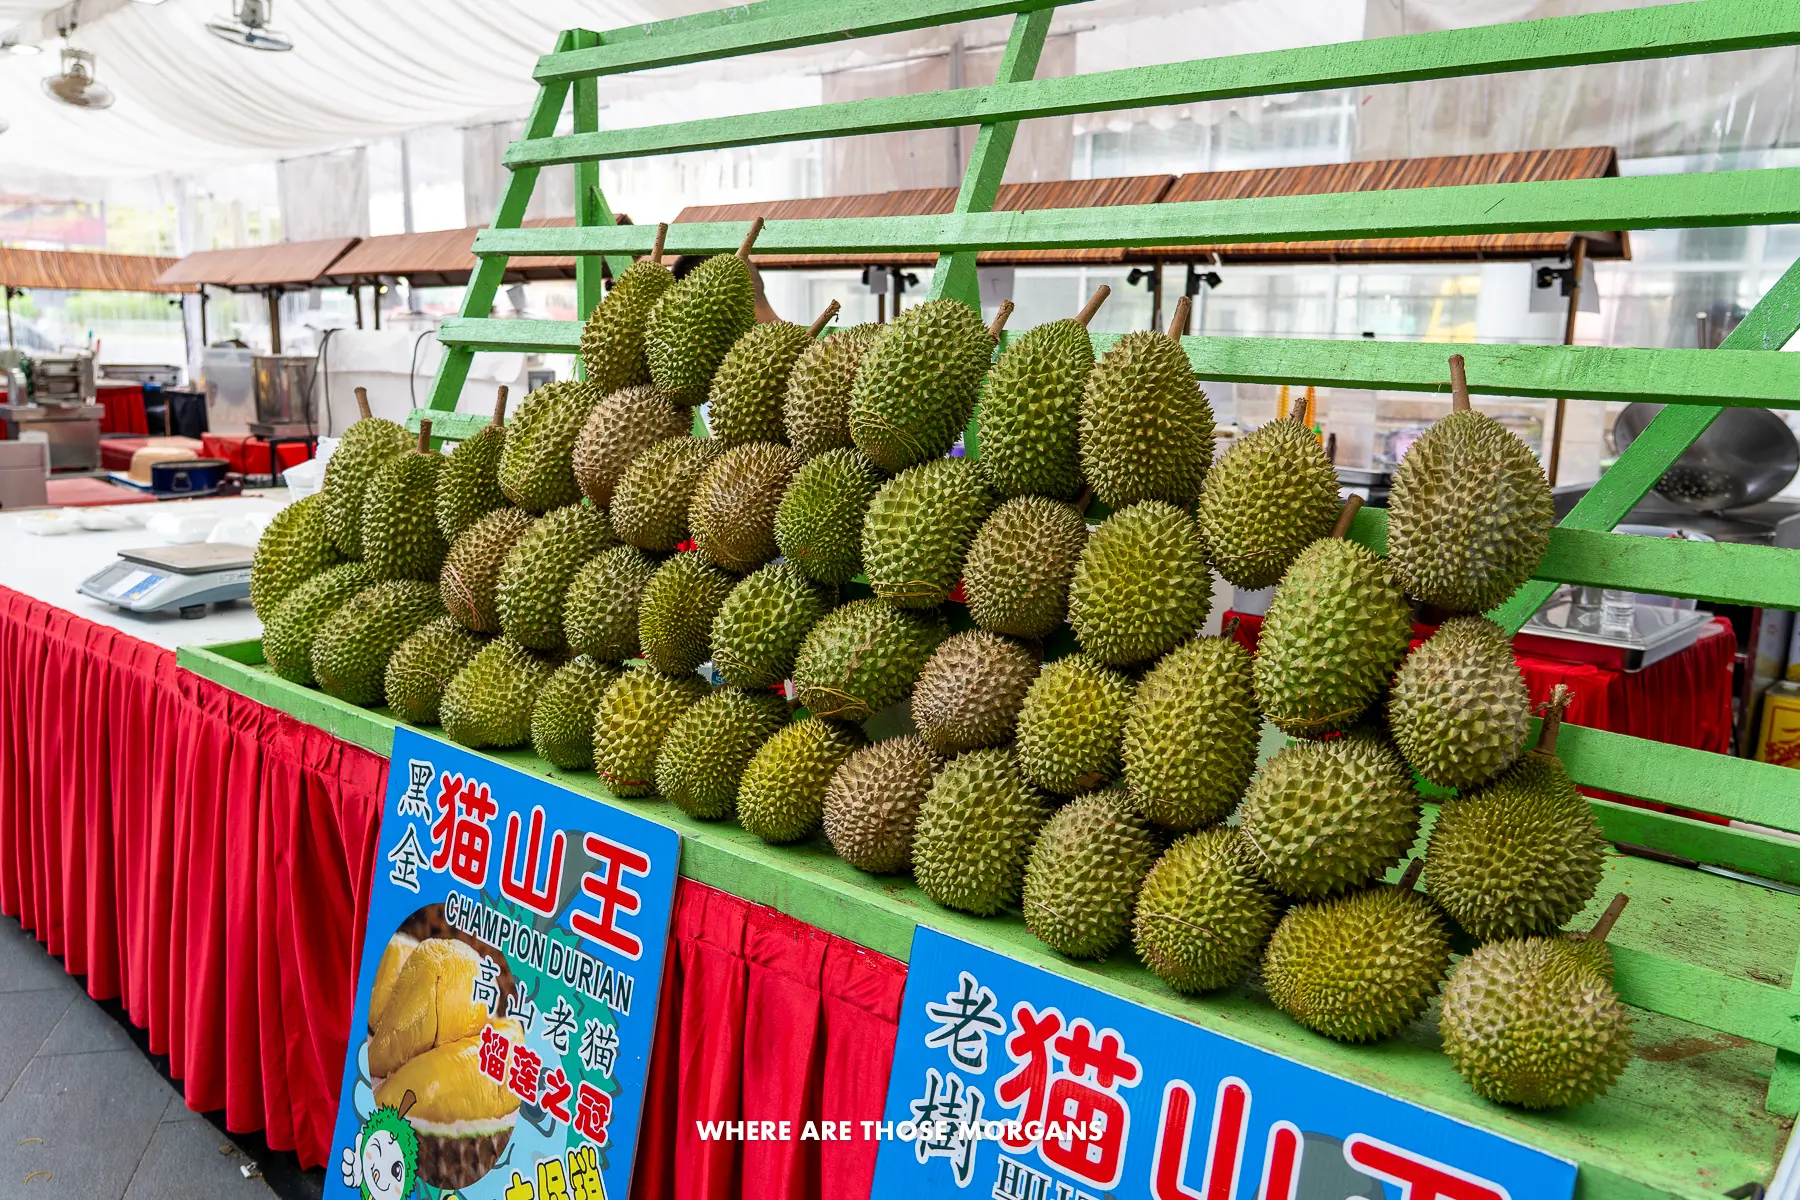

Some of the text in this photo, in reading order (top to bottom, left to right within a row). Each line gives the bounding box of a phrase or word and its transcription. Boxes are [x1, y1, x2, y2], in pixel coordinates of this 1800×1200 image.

[389, 761, 434, 891] 黑金
[432, 775, 650, 958] 猫山王
[444, 895, 634, 1013] CHAMPION DURIAN
[472, 959, 617, 1075] 高山老猫
